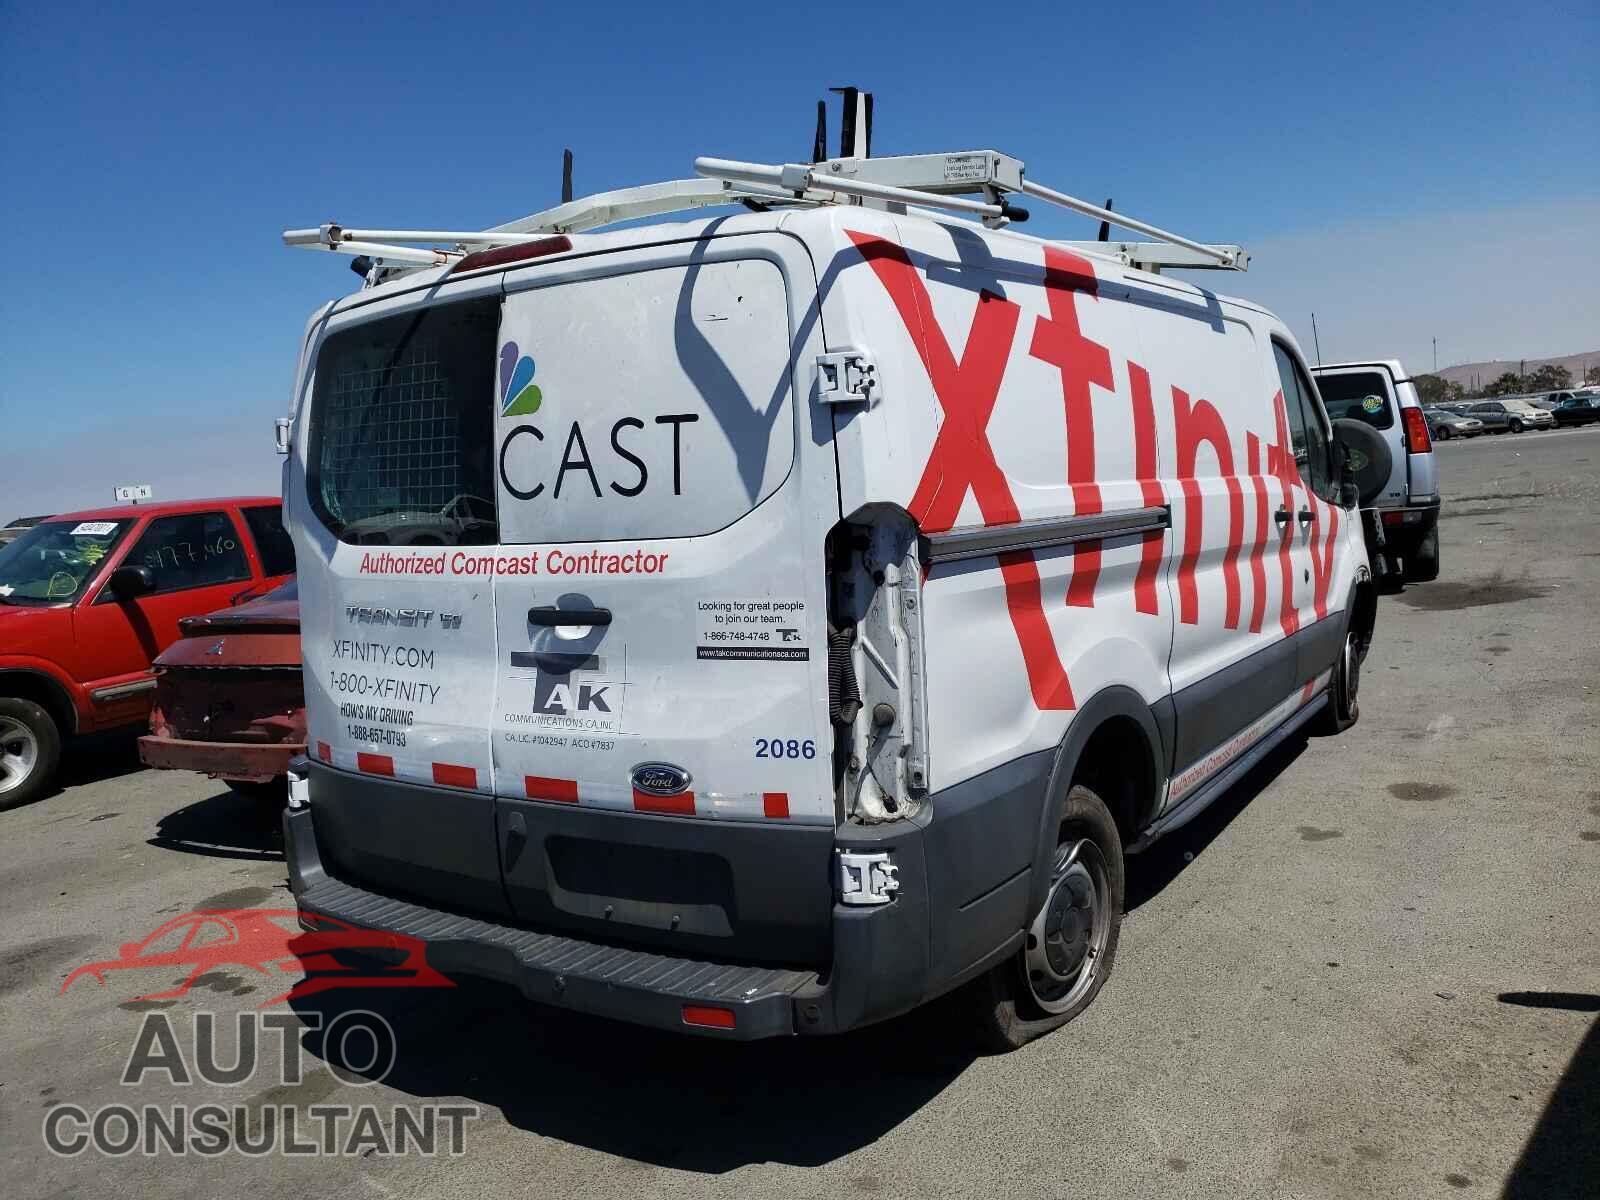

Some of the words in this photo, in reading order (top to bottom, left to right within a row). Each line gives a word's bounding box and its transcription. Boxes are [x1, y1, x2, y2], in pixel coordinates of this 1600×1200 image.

[499, 413, 699, 501] CAST
[359, 551, 446, 575] Authorized
[451, 550, 539, 575] Comcast
[546, 548, 669, 575] Contractor
[345, 606, 434, 629] TRANSIT
[698, 601, 732, 613] Looking
[733, 601, 746, 611] for
[748, 602, 771, 613] great
[773, 601, 805, 613] people
[715, 614, 724, 623] to
[725, 613, 742, 625] join
[760, 614, 786, 624] team.
[703, 631, 770, 641] 1-866-748-4748
[331, 639, 435, 670] XFINITY.COM
[329, 671, 441, 705] 1-800-XFINITY
[365, 704, 379, 722] MY
[380, 707, 414, 726] DRIVING
[504, 713, 583, 728] COMMUNICATIONS
[347, 723, 406, 747] 1-888-657-0793
[755, 738, 816, 760] 2086
[641, 769, 674, 788] Ford
